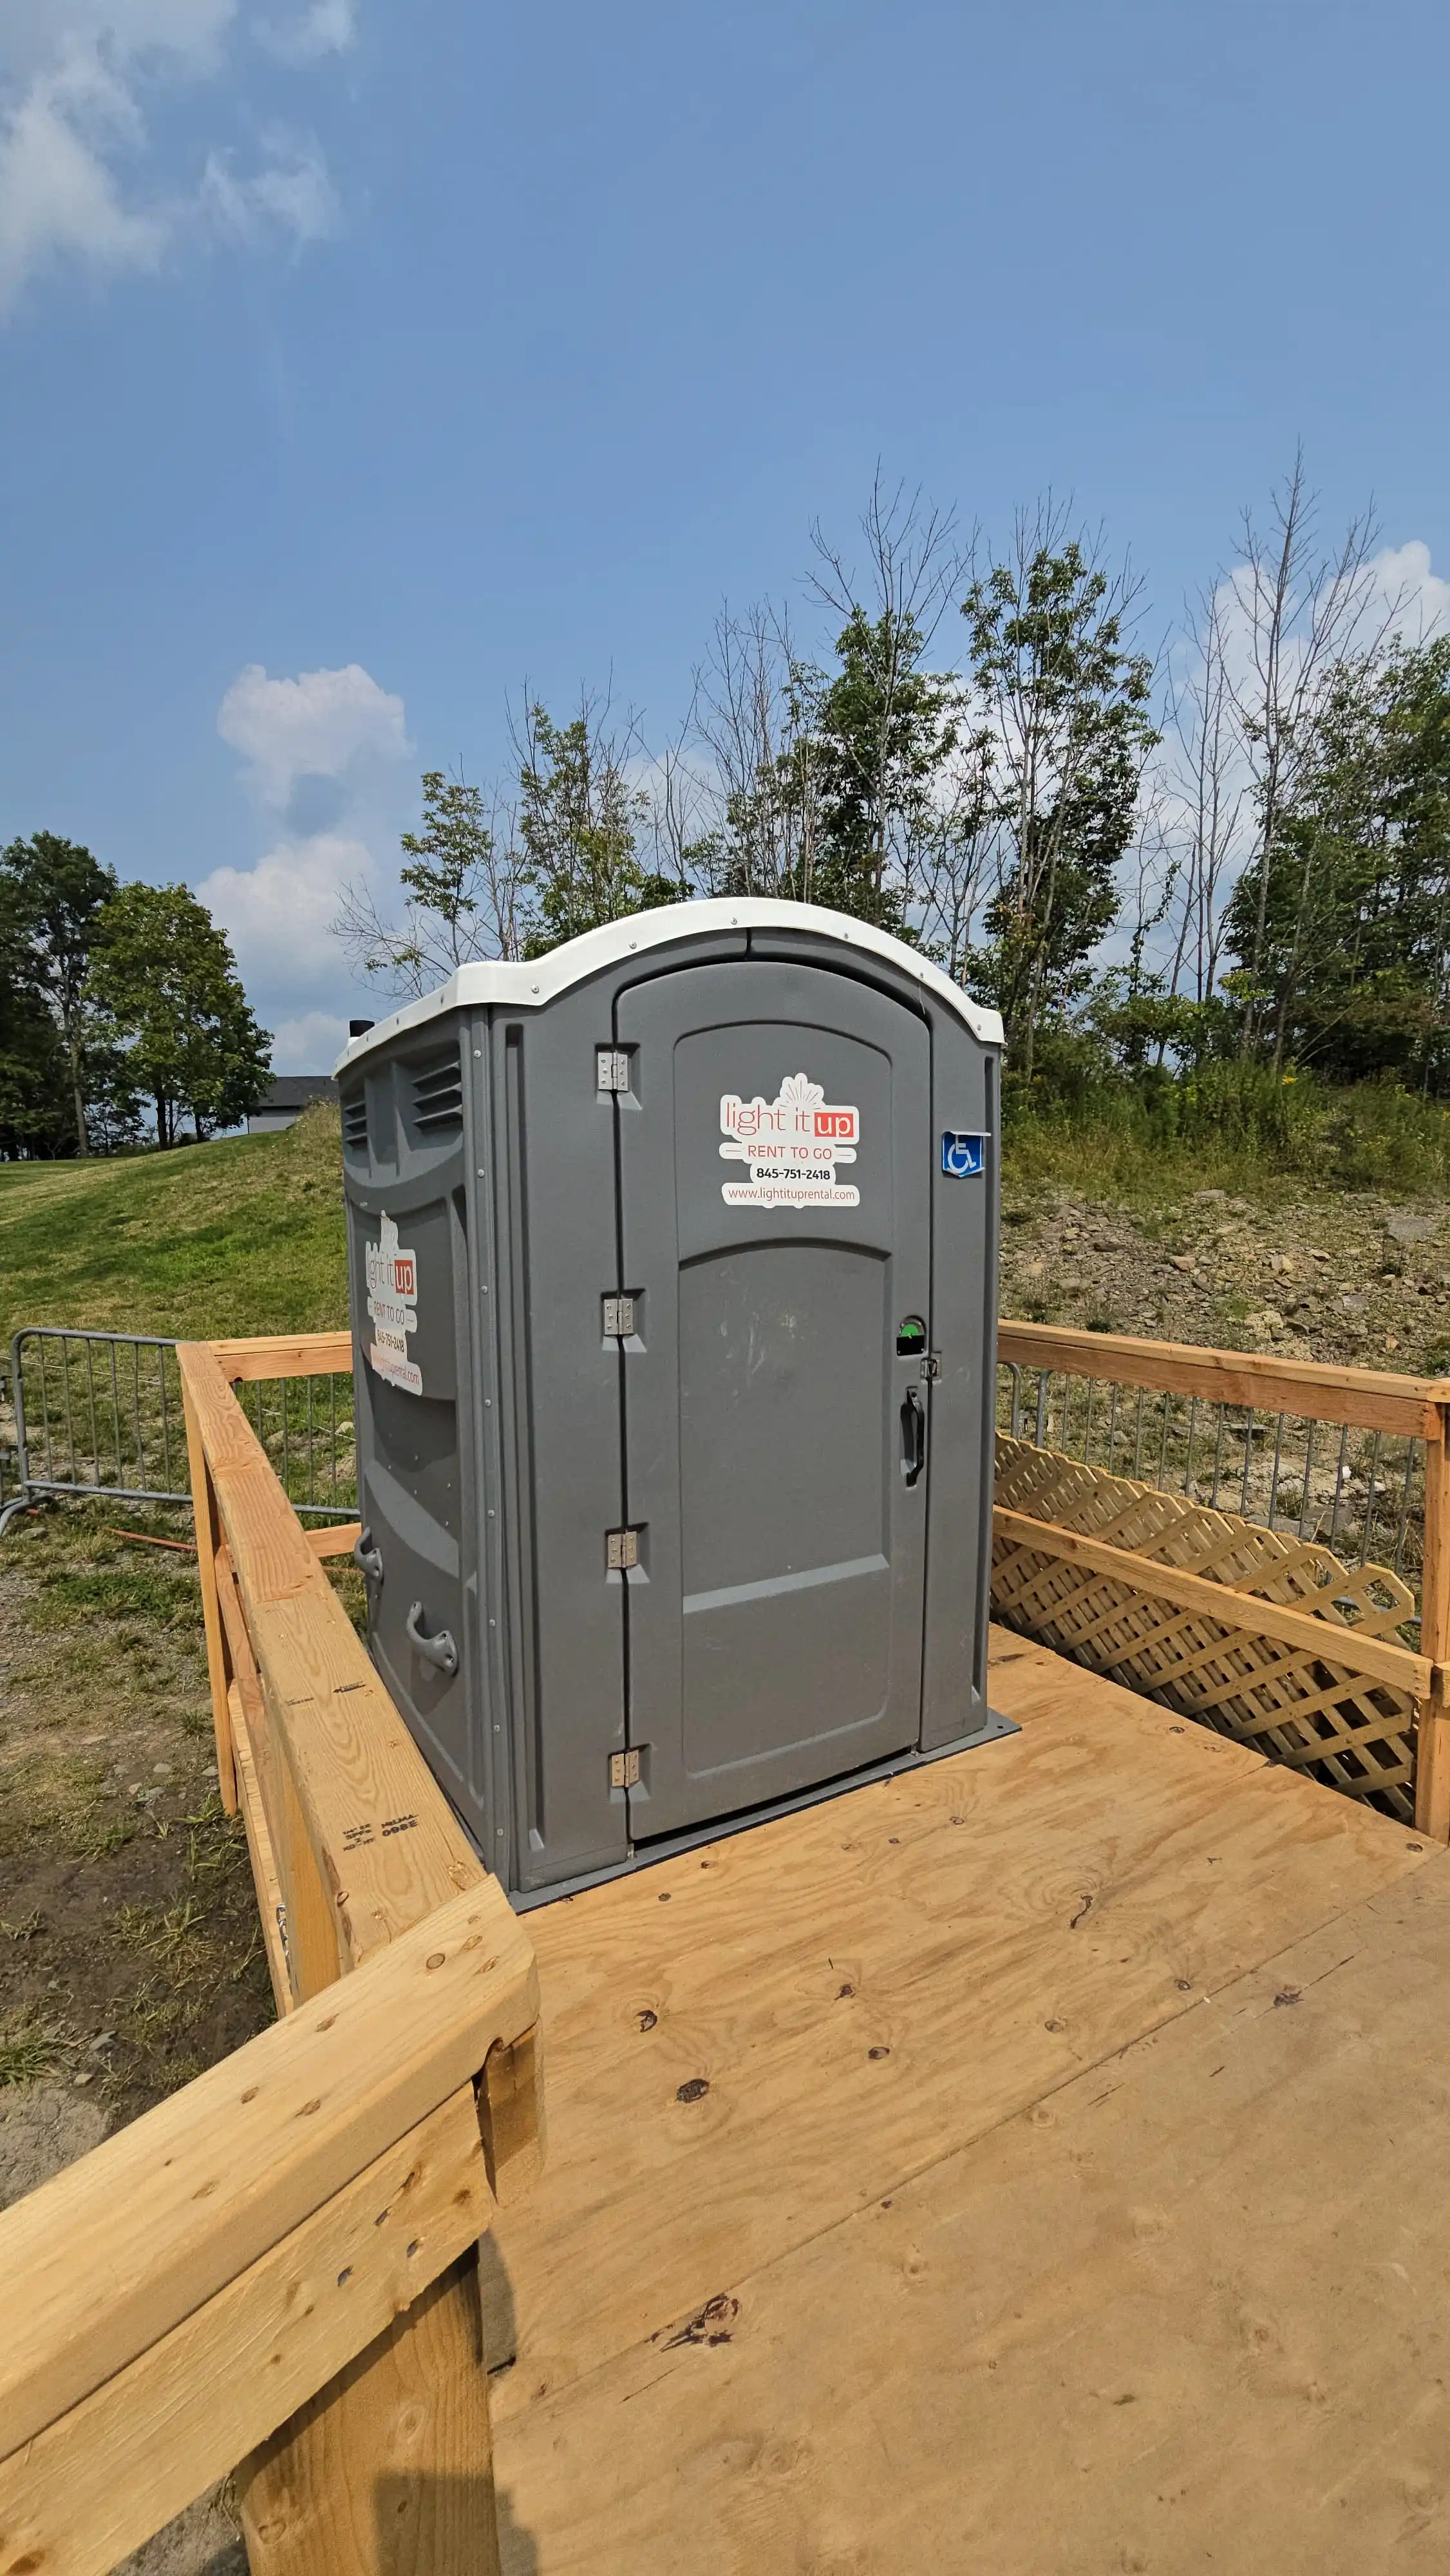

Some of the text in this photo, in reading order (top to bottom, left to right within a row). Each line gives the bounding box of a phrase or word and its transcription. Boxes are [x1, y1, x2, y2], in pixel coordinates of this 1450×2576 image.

[726, 1102, 852, 1138] light it up
[748, 1145, 833, 1160] RENT TO GO
[756, 1168, 831, 1180] 845-751-2418
[728, 1186, 855, 1202] www.lightituprental.com
[395, 1265, 413, 1294] up
[386, 1305, 395, 1321] TO
[395, 1308, 404, 1325] GO
